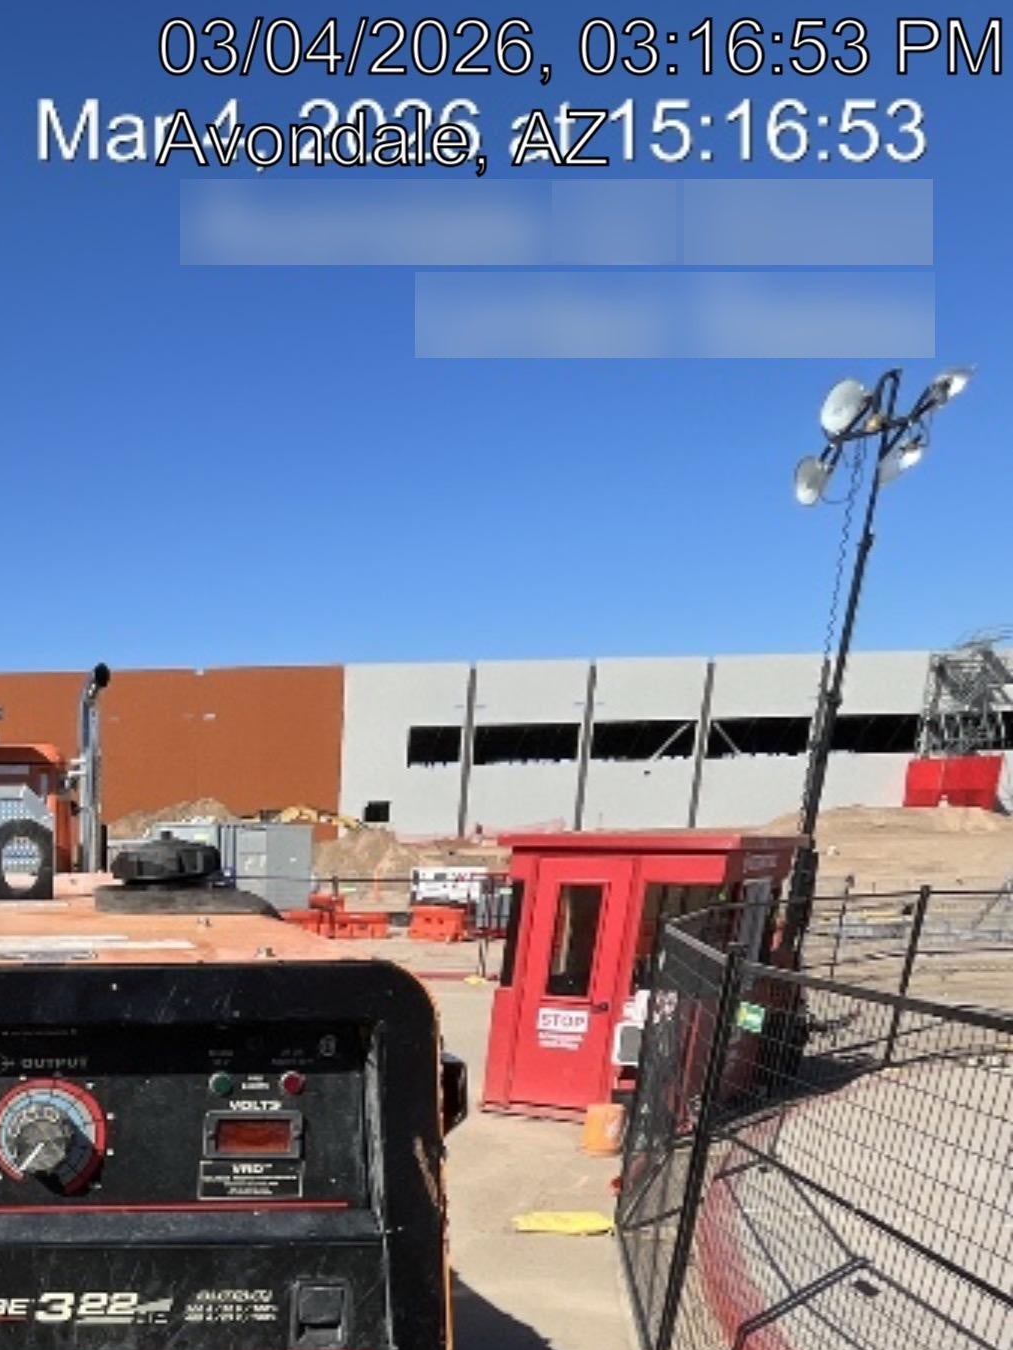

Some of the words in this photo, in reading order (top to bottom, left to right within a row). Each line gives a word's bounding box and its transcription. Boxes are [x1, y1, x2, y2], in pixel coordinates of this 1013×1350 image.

[541, 1013, 585, 1028] STOP
[20, 1057, 89, 1069] OUTPUT
[228, 1099, 282, 1111] VOLTS
[34, 1291, 139, 1323] 322
